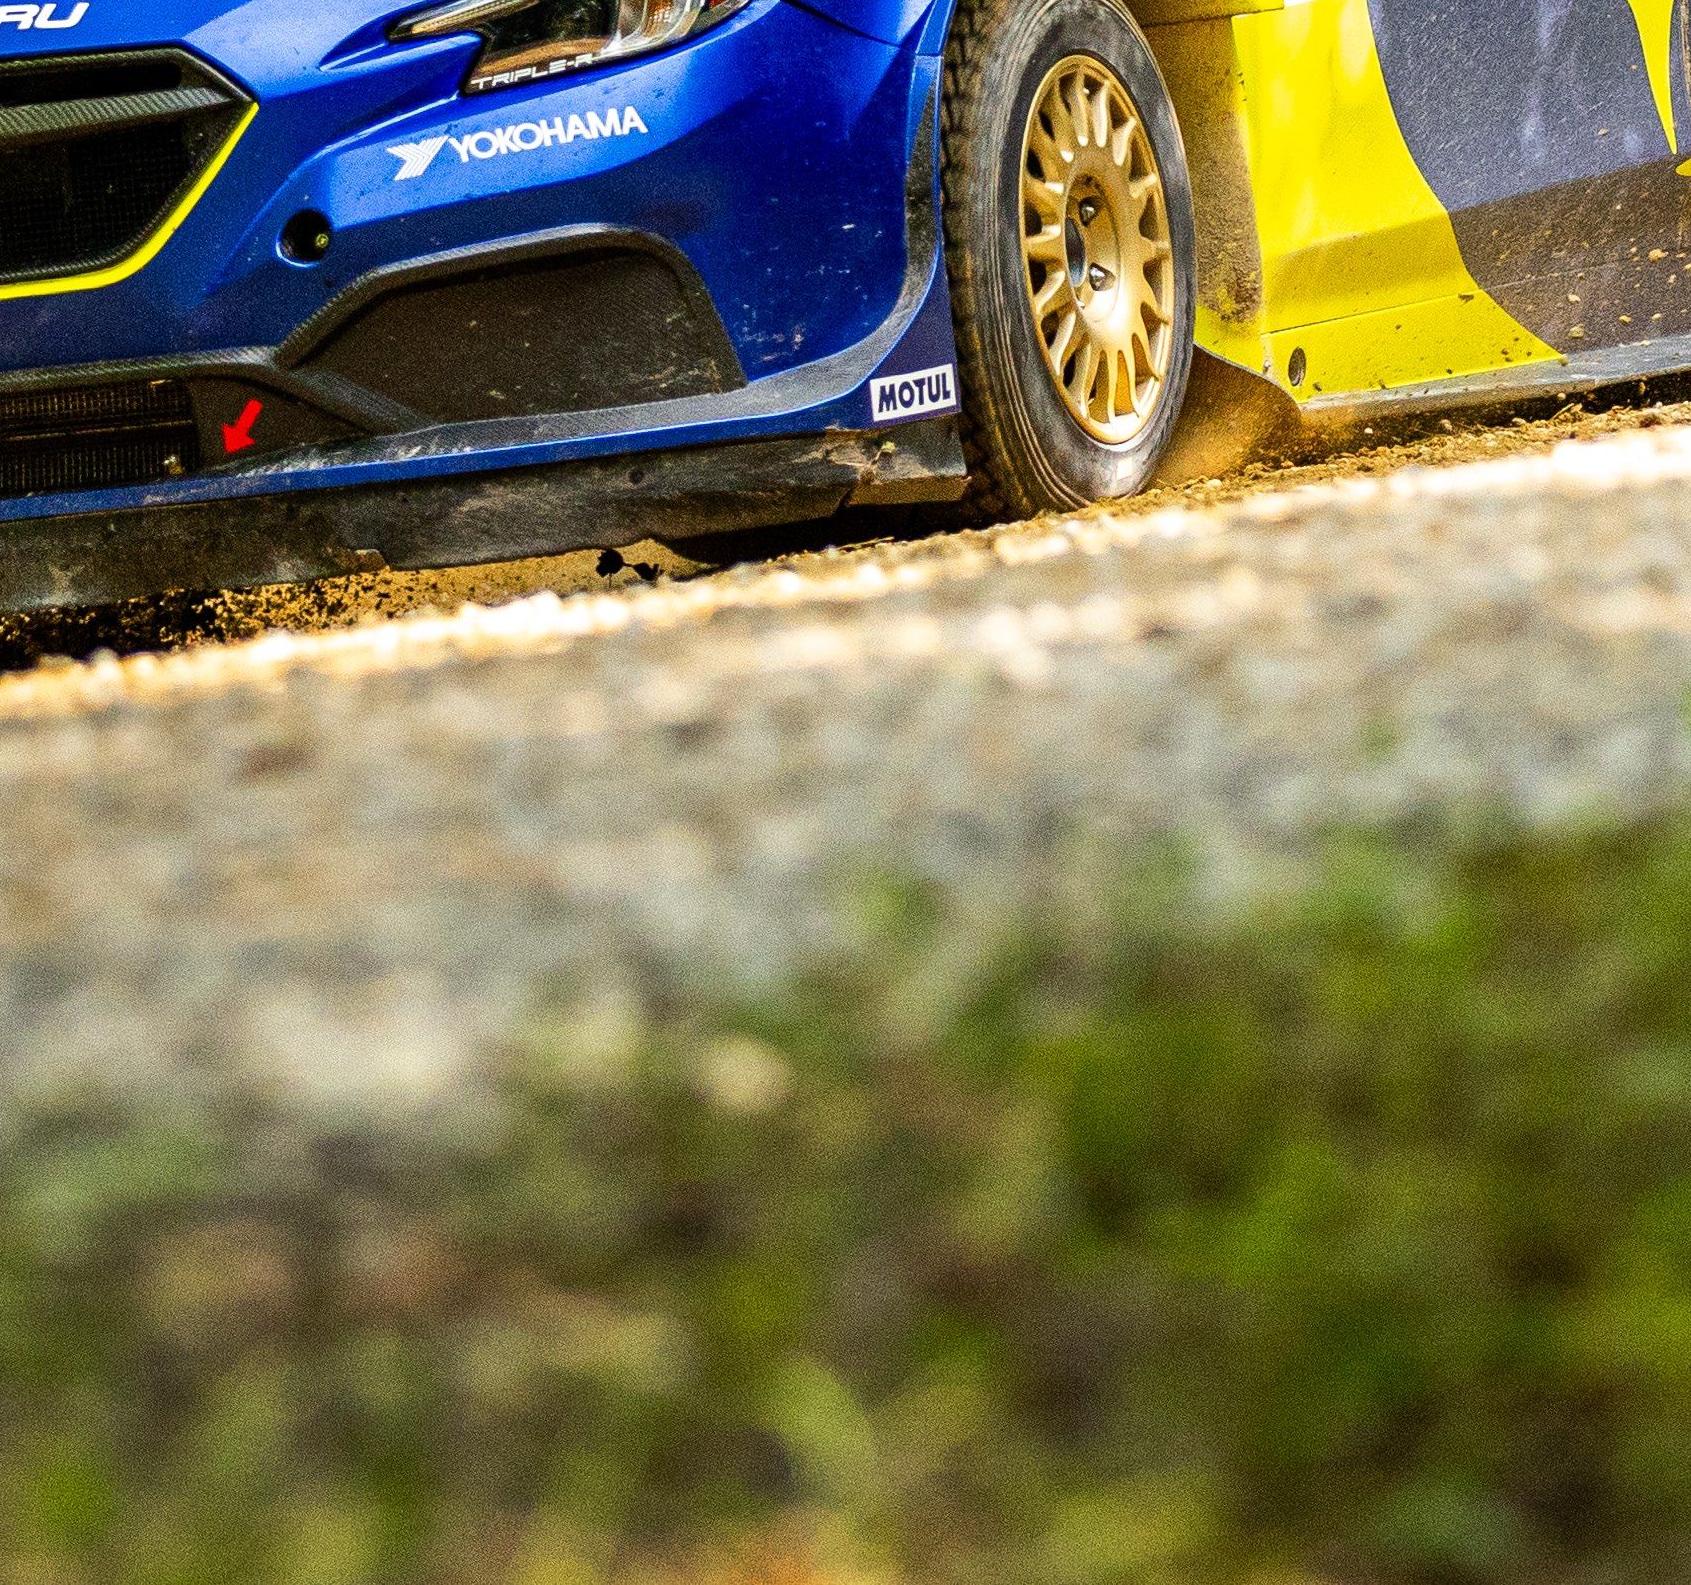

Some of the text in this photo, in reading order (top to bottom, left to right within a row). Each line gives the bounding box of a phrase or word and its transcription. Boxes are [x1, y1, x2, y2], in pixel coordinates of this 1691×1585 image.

[470, 53, 593, 90] TRIPLE-R
[449, 105, 649, 163] YOKOHAMA
[878, 372, 951, 413] MOTUL
